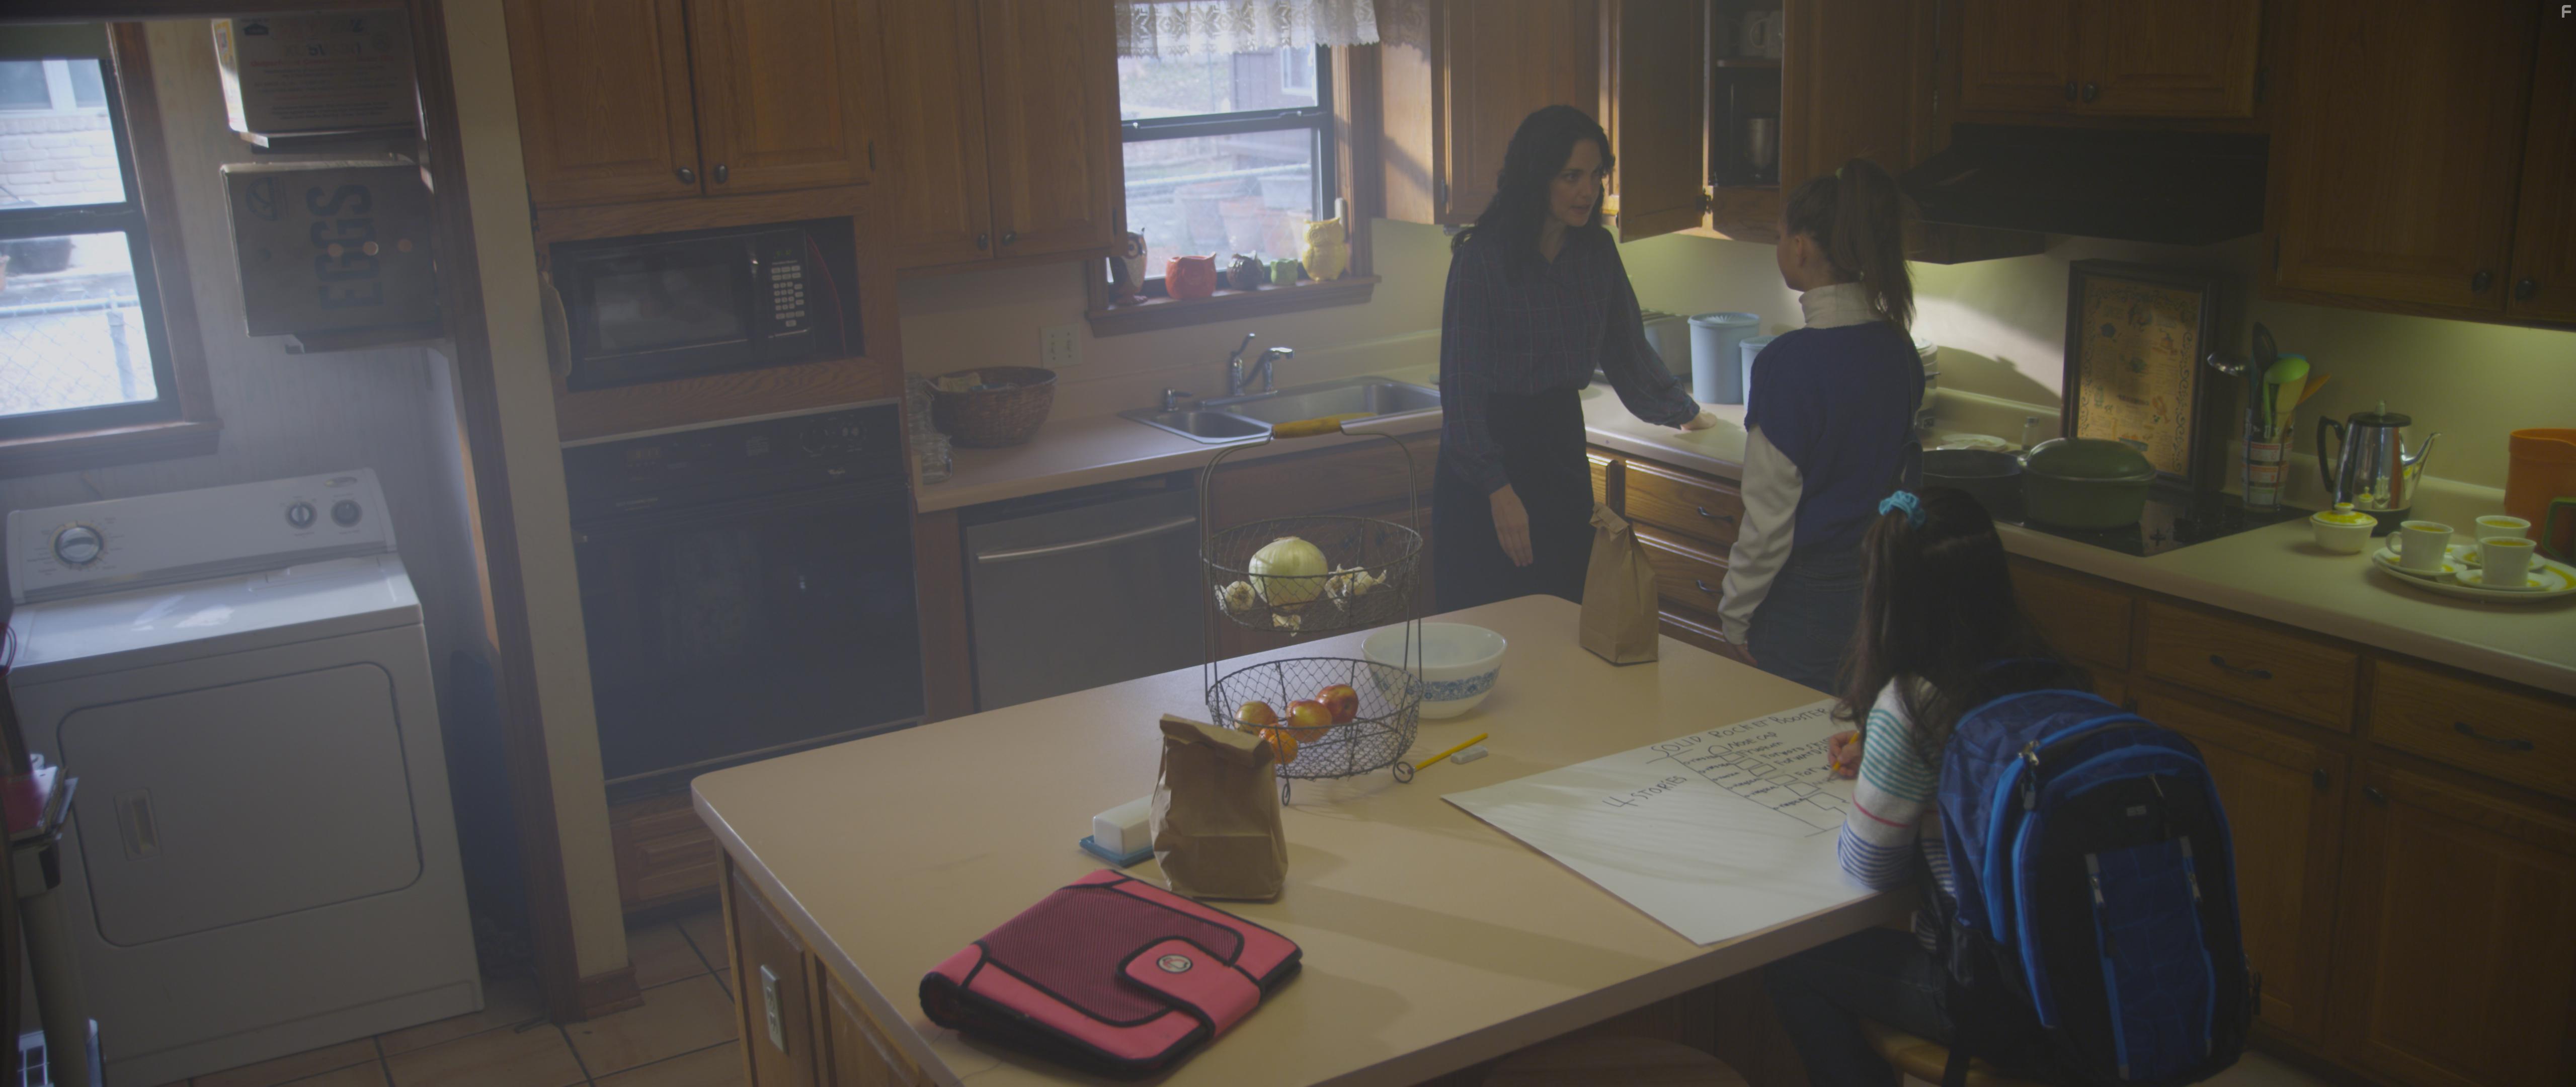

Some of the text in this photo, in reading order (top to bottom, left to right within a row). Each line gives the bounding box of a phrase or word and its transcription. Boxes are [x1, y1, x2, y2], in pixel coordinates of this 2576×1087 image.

[305, 184, 385, 311] EGGS
[1650, 708, 1828, 757] SOLID ROCKET BOOSTER
[1630, 775, 1687, 800] STORIES
